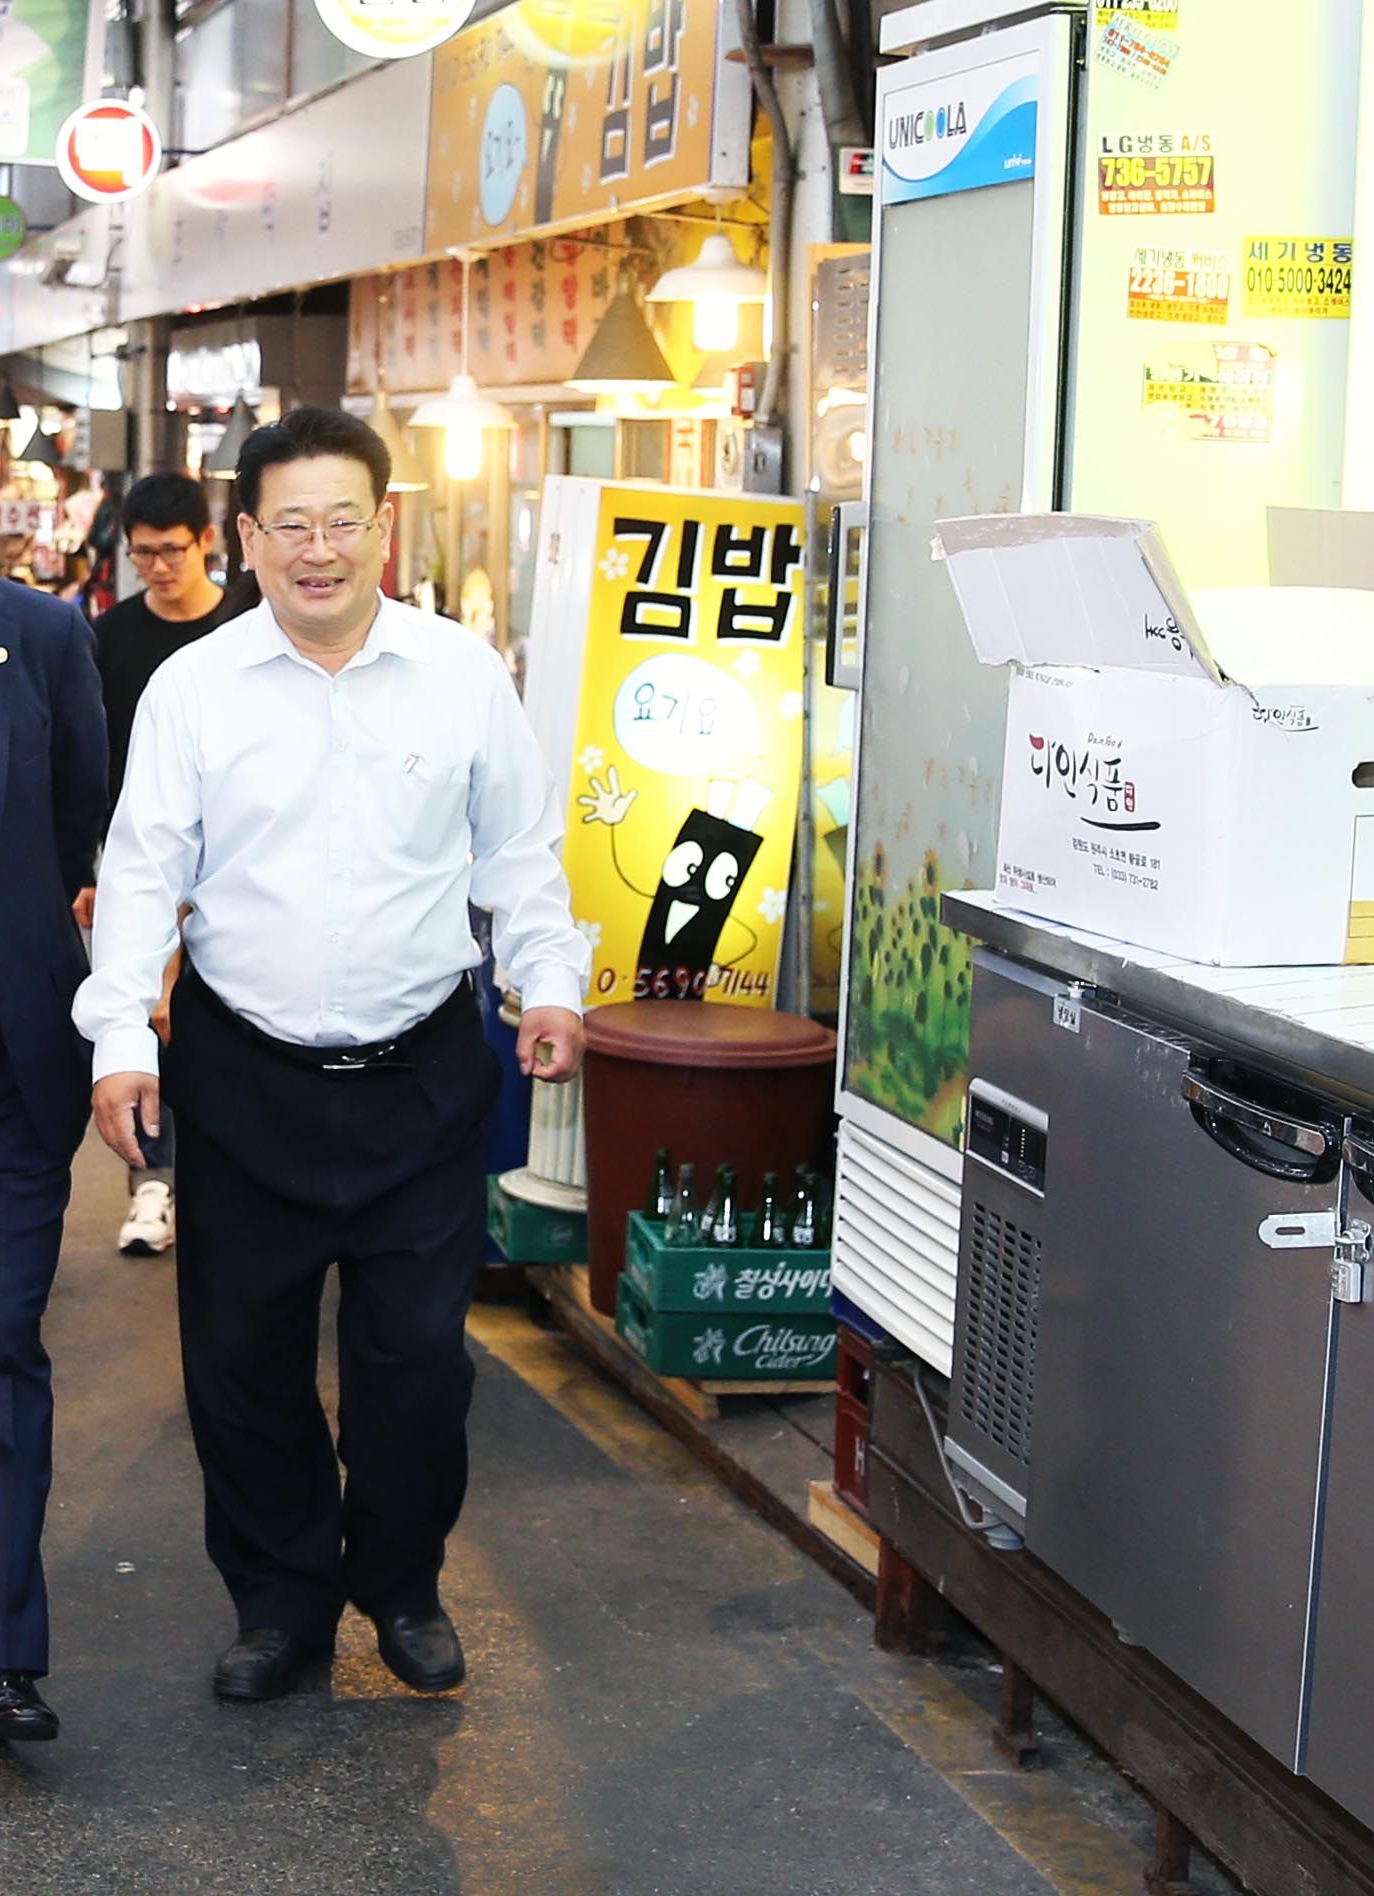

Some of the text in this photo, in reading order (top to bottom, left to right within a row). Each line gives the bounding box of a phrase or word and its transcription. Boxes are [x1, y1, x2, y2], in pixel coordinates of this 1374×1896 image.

[1180, 134, 1212, 153] A/S
[1101, 157, 1212, 188] 736-5757
[614, 517, 803, 643] 김밥
[632, 682, 716, 735] 요기요
[1029, 733, 1124, 812] 다인식품
[733, 1324, 838, 1366] Chilsung
[755, 1352, 813, 1369] Cider
